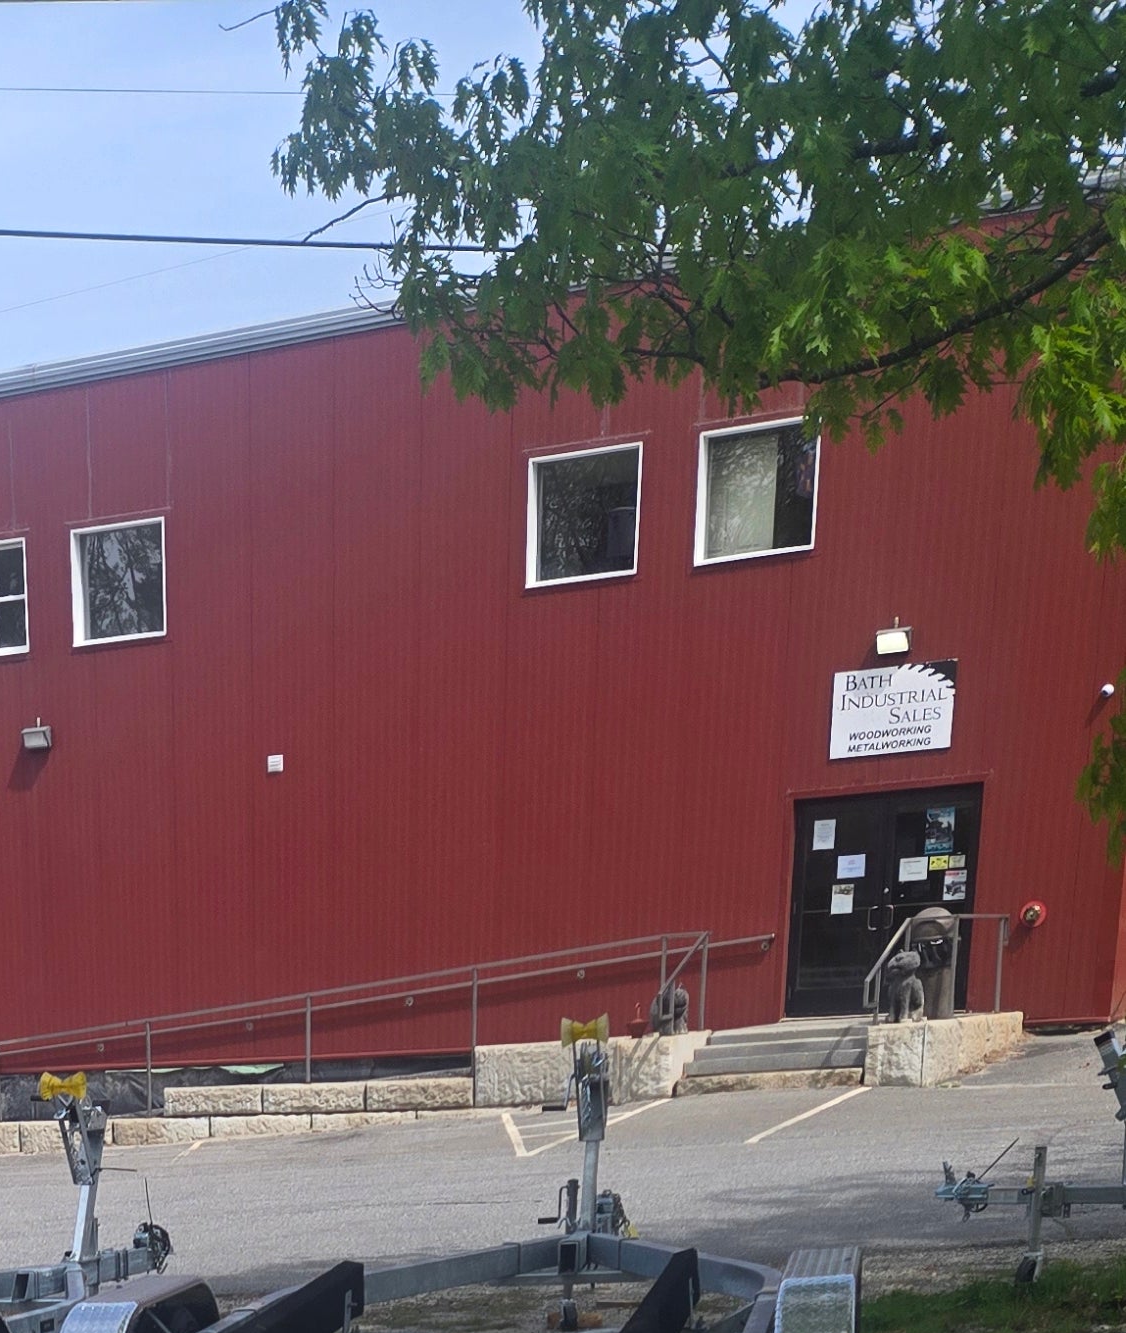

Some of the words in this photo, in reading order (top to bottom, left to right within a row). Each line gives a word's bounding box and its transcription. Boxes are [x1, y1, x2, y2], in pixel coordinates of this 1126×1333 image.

[846, 674, 892, 691] BATH
[841, 688, 947, 711] INDUSTRIAL
[889, 707, 941, 725] SALES
[849, 725, 932, 741] WOODWORKING
[847, 737, 931, 753] METALWORKING
